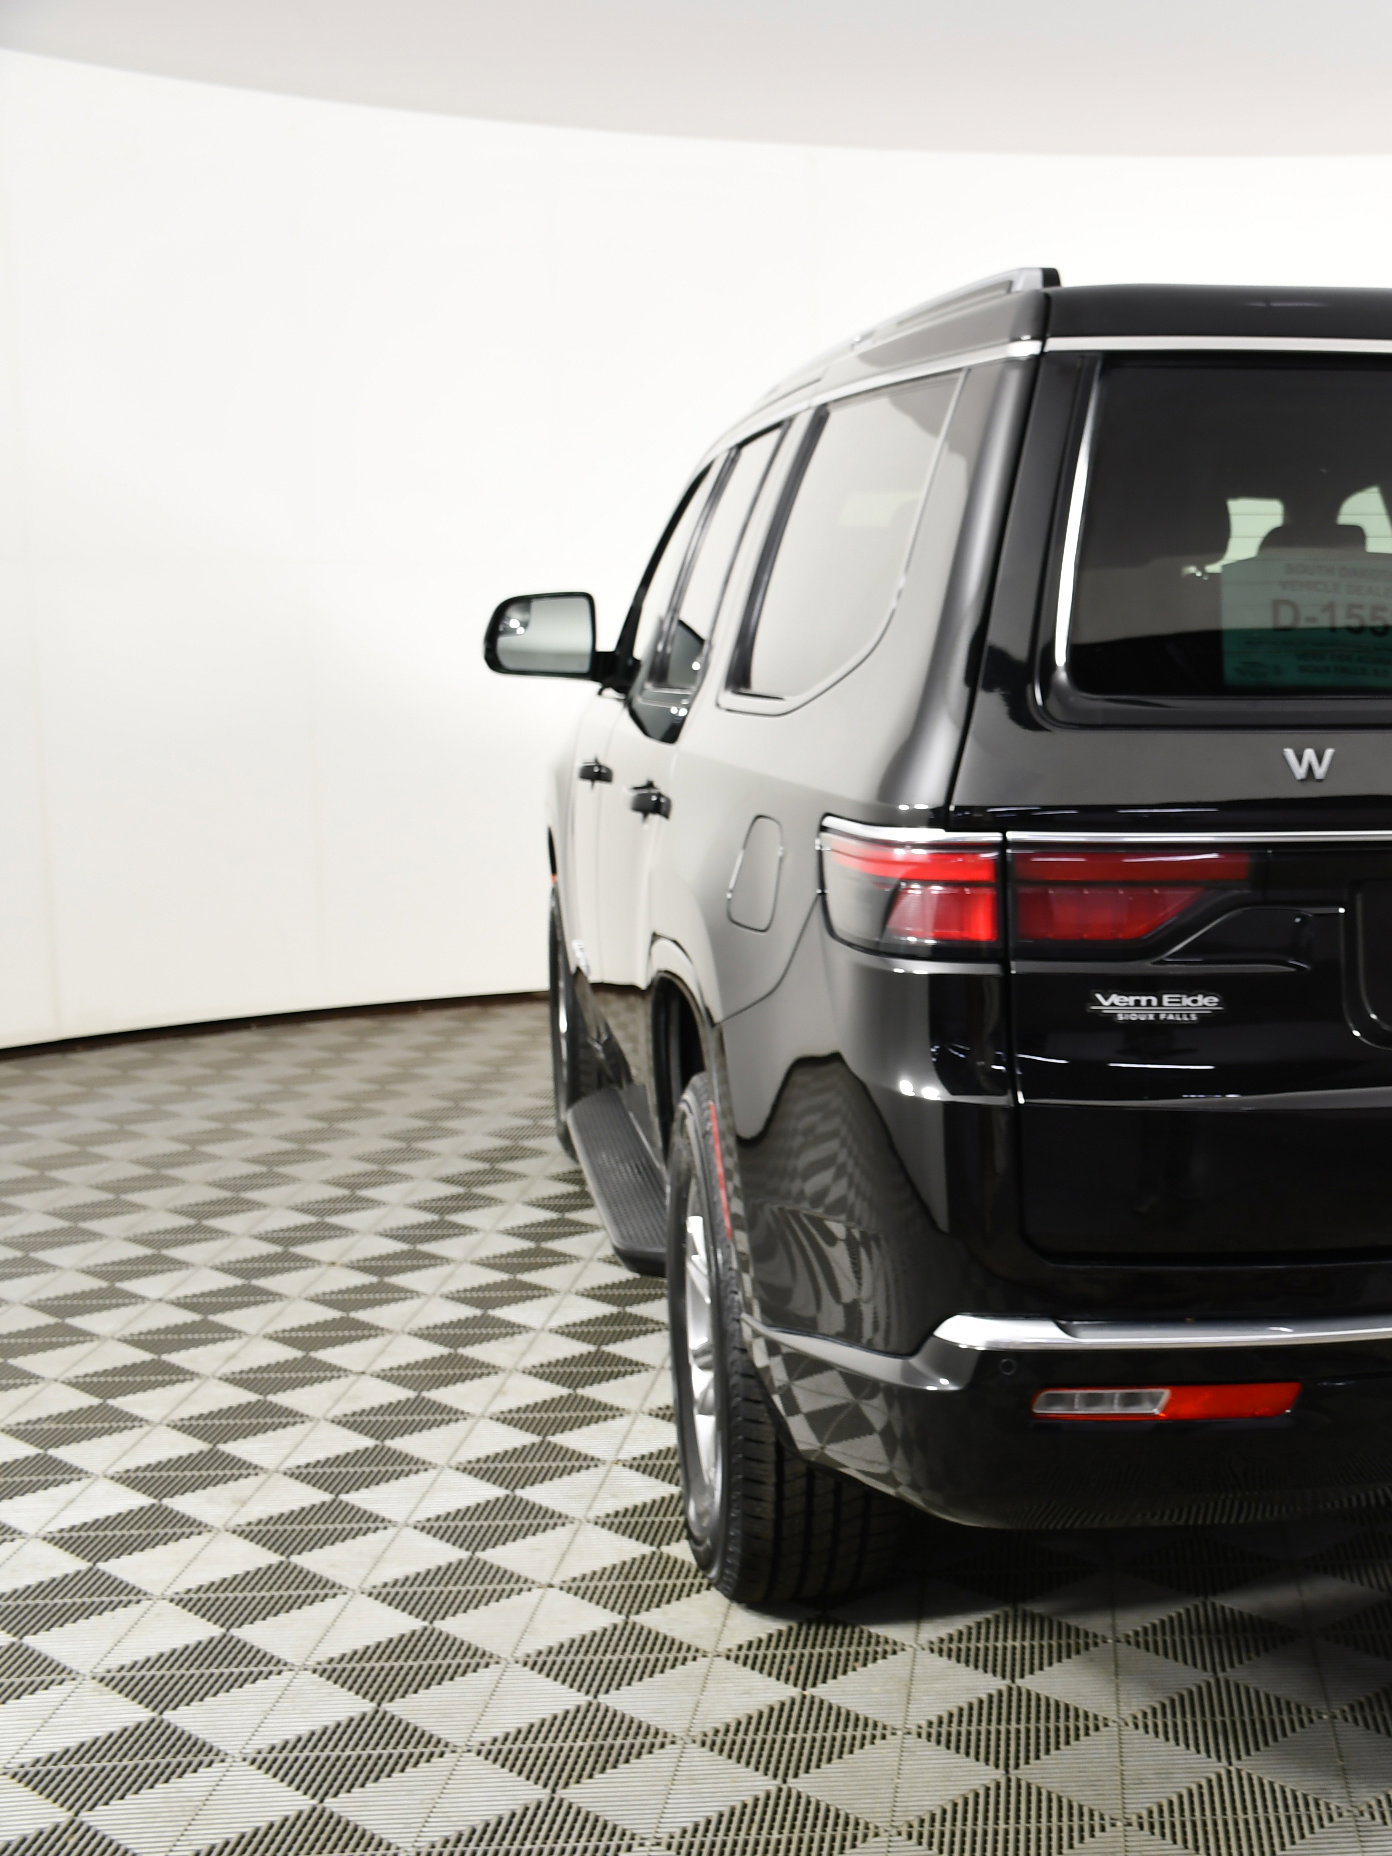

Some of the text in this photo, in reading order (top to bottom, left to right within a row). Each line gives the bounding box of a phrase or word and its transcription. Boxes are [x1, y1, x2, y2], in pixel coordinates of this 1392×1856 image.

[1094, 993, 1220, 1007] Vern Eide
[1117, 1013, 1198, 1021] SIOUX FALLS
